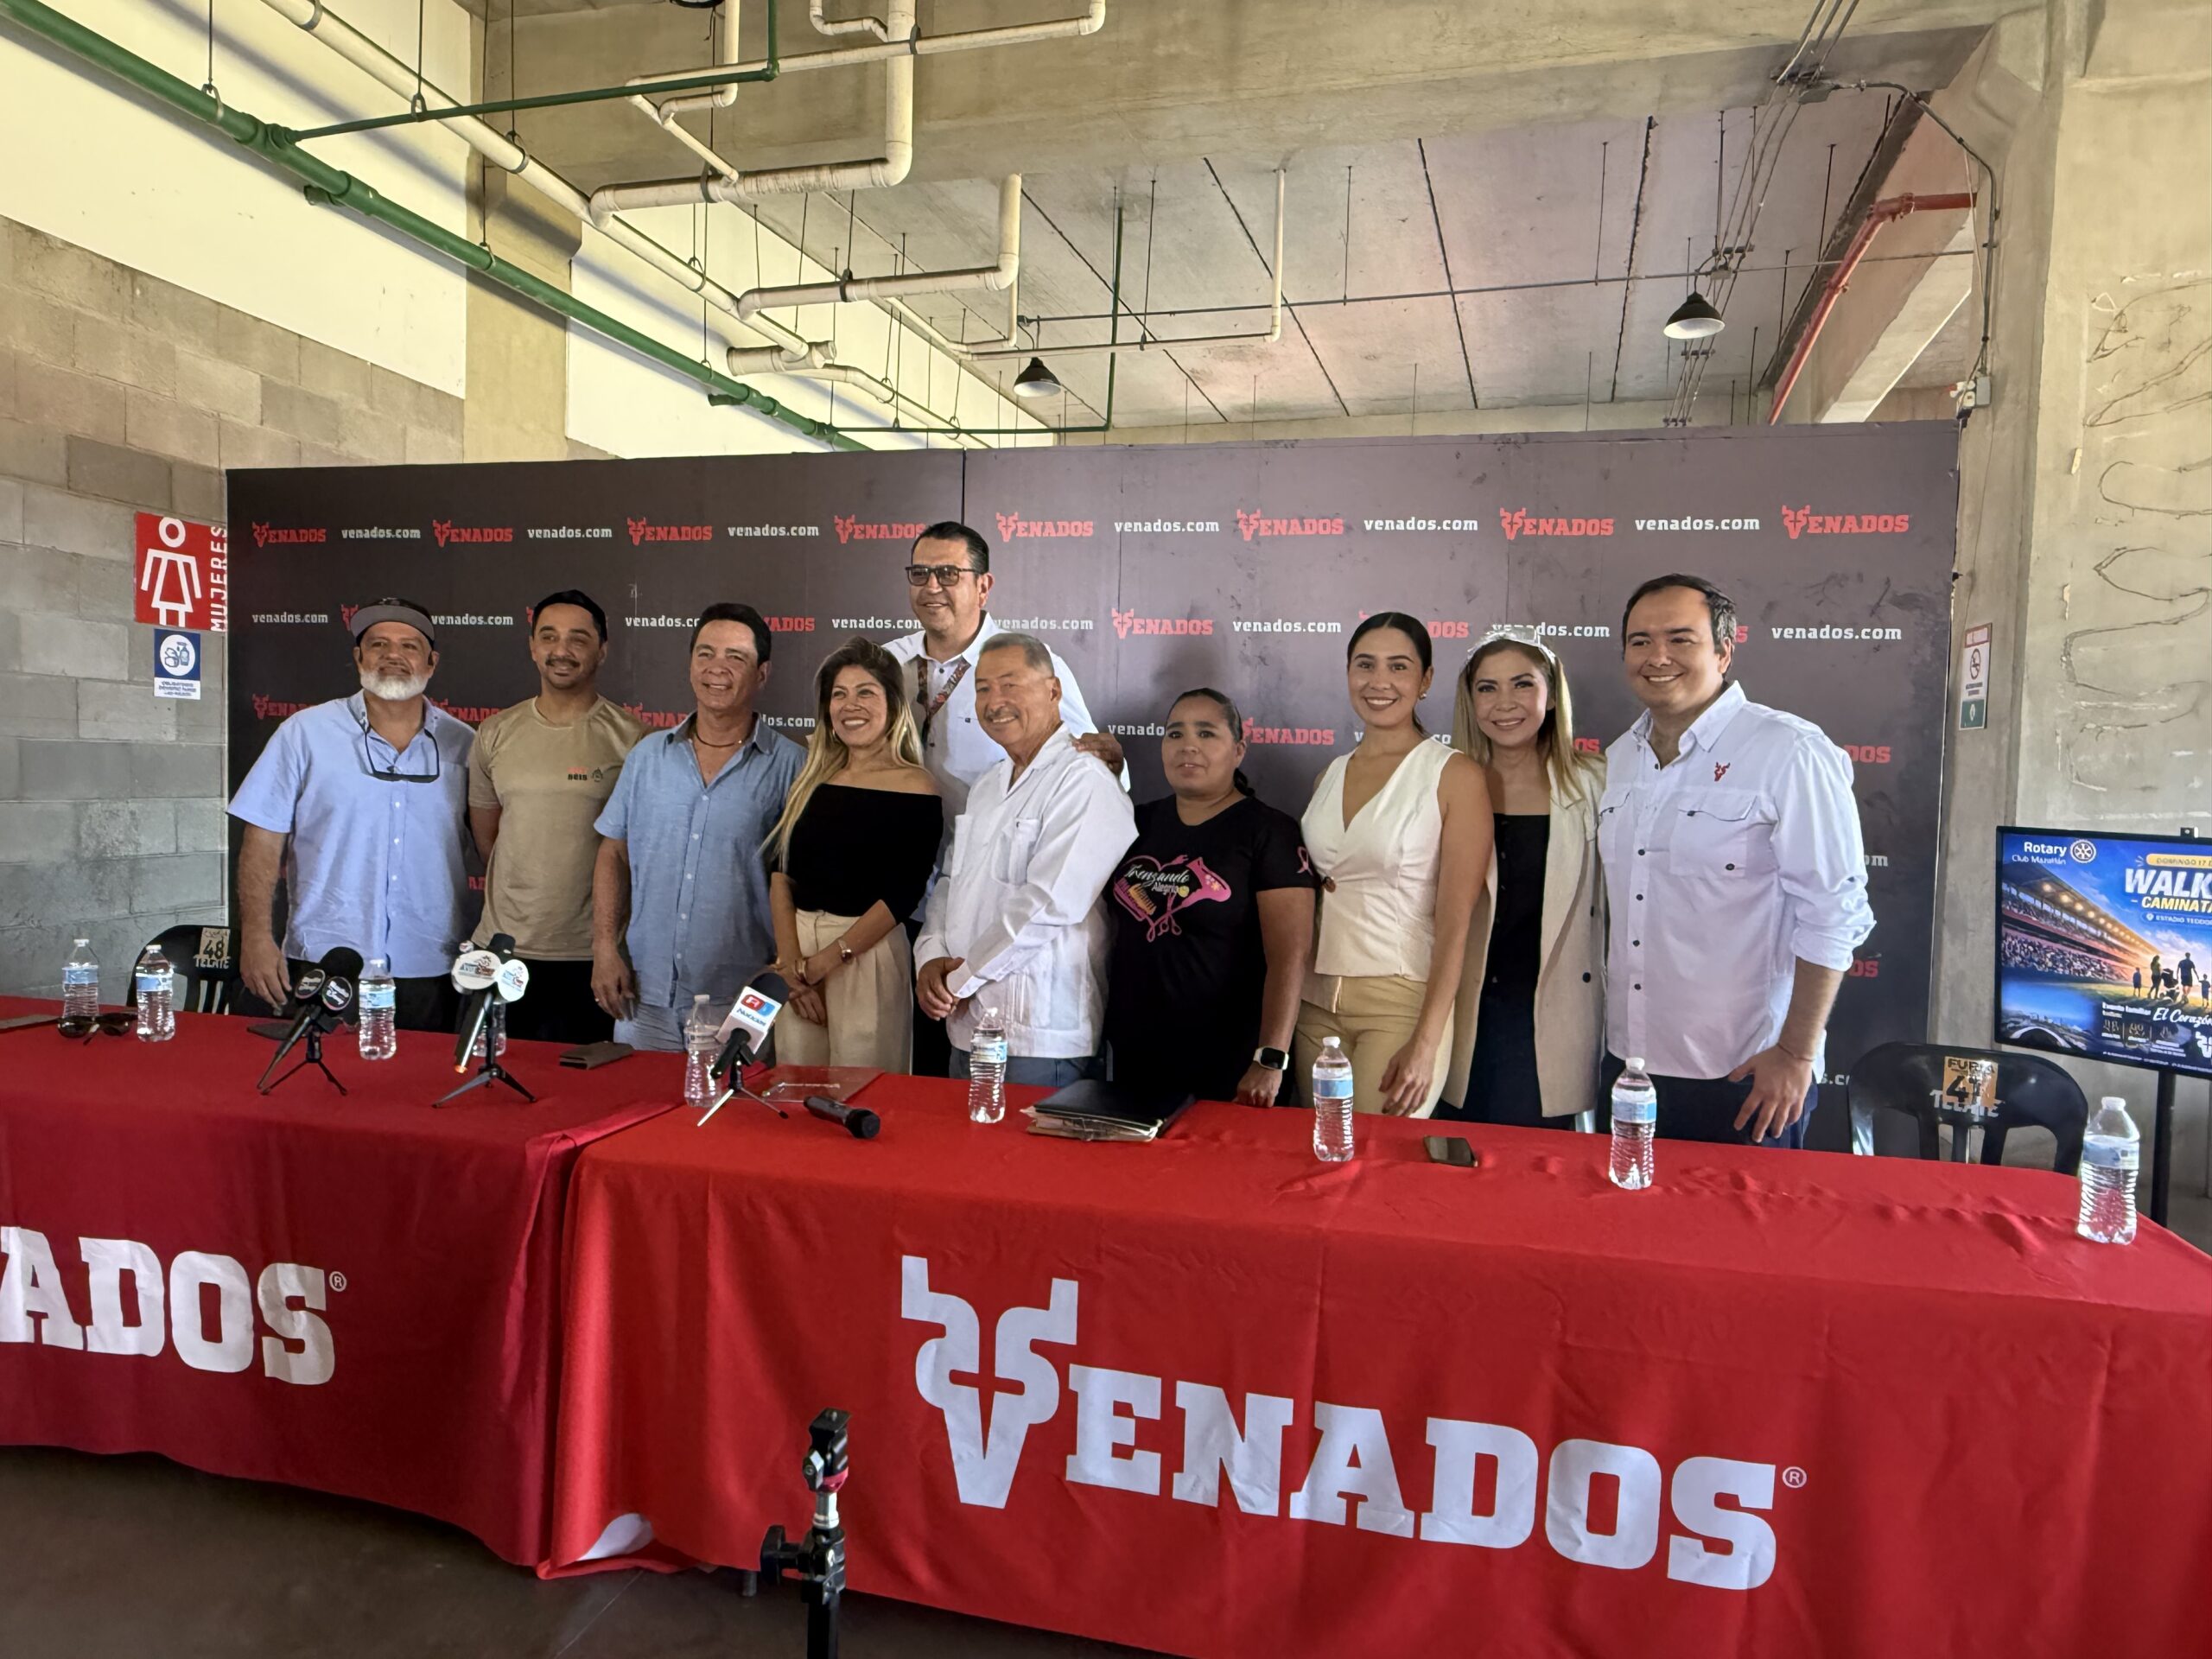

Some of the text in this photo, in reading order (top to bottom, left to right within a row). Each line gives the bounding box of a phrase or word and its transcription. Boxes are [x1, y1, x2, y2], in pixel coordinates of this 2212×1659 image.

[995, 512, 1094, 543] VENADOS
[1114, 518, 1220, 533] venados.com
[1236, 509, 1344, 541] VENADOS
[1363, 517, 1478, 531] venados.com
[1500, 507, 1615, 540] VENADOS
[1635, 516, 1760, 531] venados.com
[1782, 505, 1910, 539] VENADOS
[252, 521, 327, 547] VENADOS
[341, 526, 421, 539] venados.com
[433, 519, 513, 548] VENADOS
[527, 526, 613, 538] venados.com
[627, 517, 713, 546] VENADOS
[728, 524, 819, 537] venados.com
[251, 612, 328, 624] venados.com
[431, 613, 514, 626] venados.com
[625, 614, 700, 628] venados.c
[764, 616, 816, 632] ADOS
[1111, 608, 1214, 639] VENADOS
[1232, 619, 1342, 633] venados.com
[1492, 621, 1611, 638] vdos.com
[1771, 625, 1902, 640] venados.com
[252, 694, 315, 720] VENA
[1108, 723, 1165, 736] venado
[2024, 842, 2067, 857] Rotary
[2125, 868, 2212, 899] WALK
[2152, 1007, 2169, 1021] El
[1948, 1058, 1995, 1073] FURA
[0, 1225, 335, 1386] ADOS
[901, 1255, 1777, 1591] VENADOS
